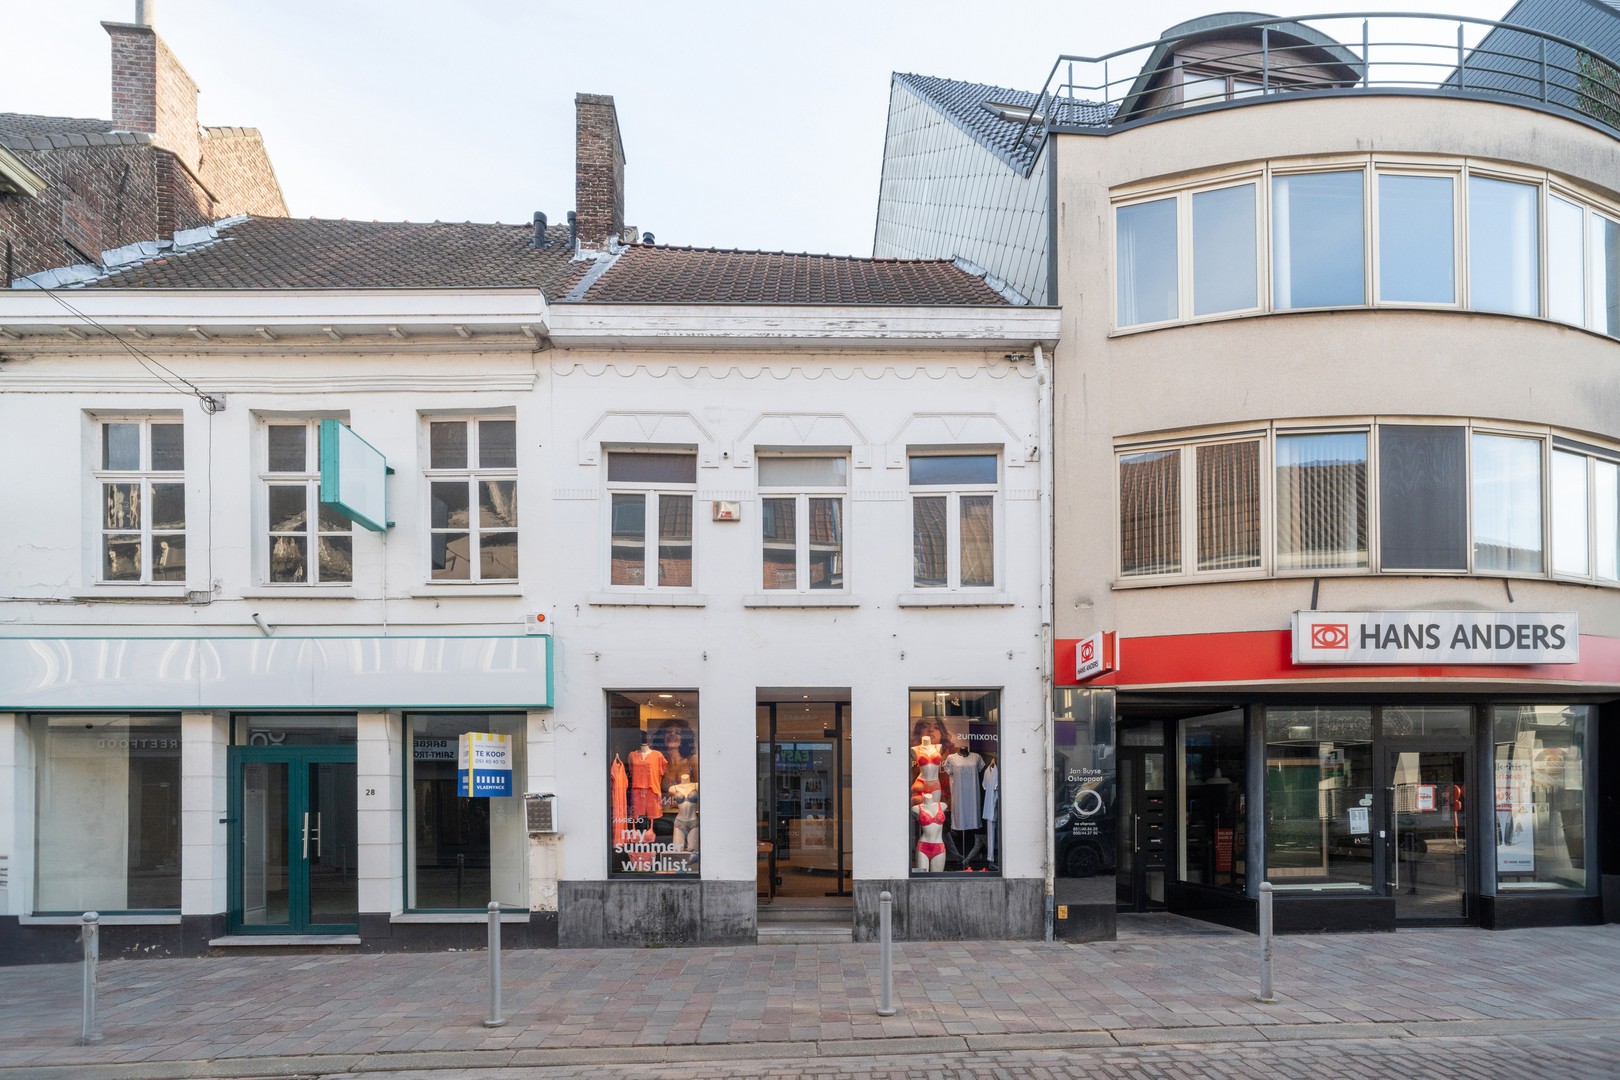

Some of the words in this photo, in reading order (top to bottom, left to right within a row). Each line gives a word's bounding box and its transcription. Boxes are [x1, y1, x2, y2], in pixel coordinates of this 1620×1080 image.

[1360, 623, 1441, 650] HANS
[1450, 623, 1566, 650] ANDERS
[1083, 768, 1101, 776] Buyse
[1068, 775, 1103, 783] Osteopaat
[621, 829, 647, 843] my
[615, 842, 684, 854] summer
[621, 857, 692, 873] wishlist.
